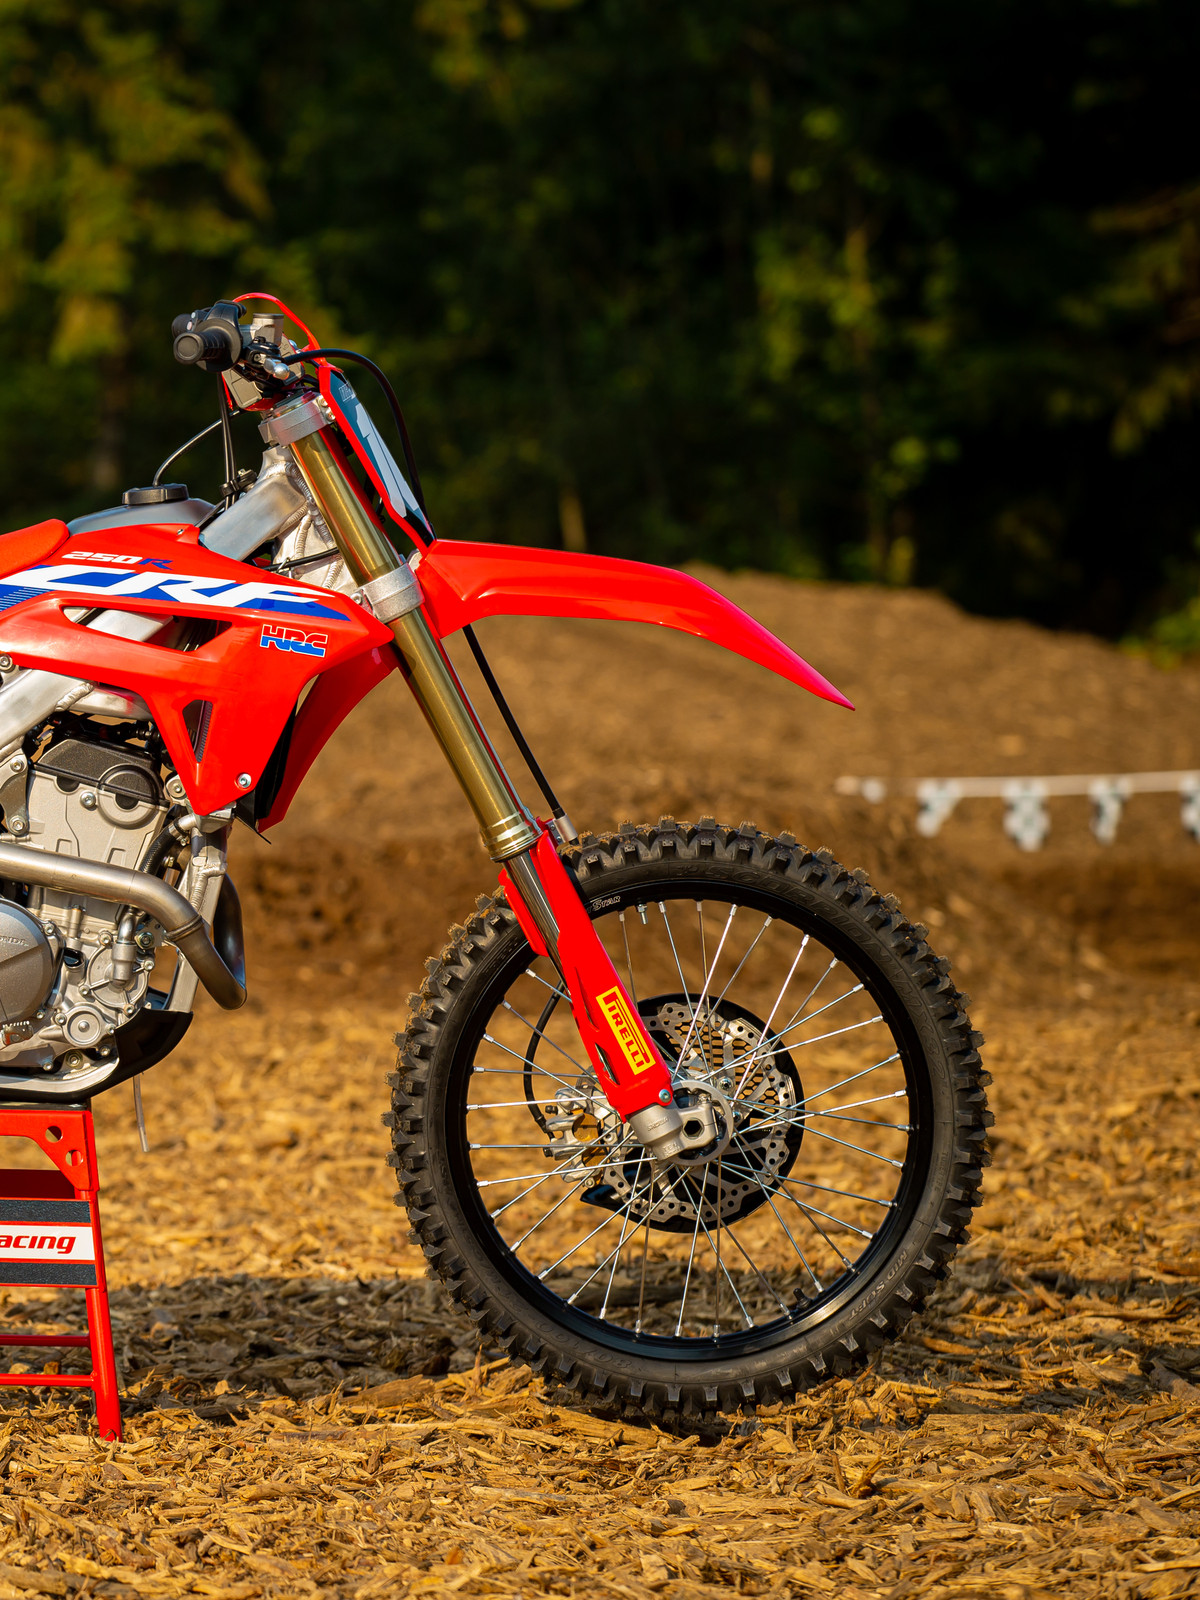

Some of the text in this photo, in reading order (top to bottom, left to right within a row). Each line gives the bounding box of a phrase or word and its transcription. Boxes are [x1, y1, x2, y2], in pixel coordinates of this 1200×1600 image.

[62, 550, 174, 571] 250R
[260, 624, 329, 657] HRC
[602, 990, 650, 1068] PIRELLI
